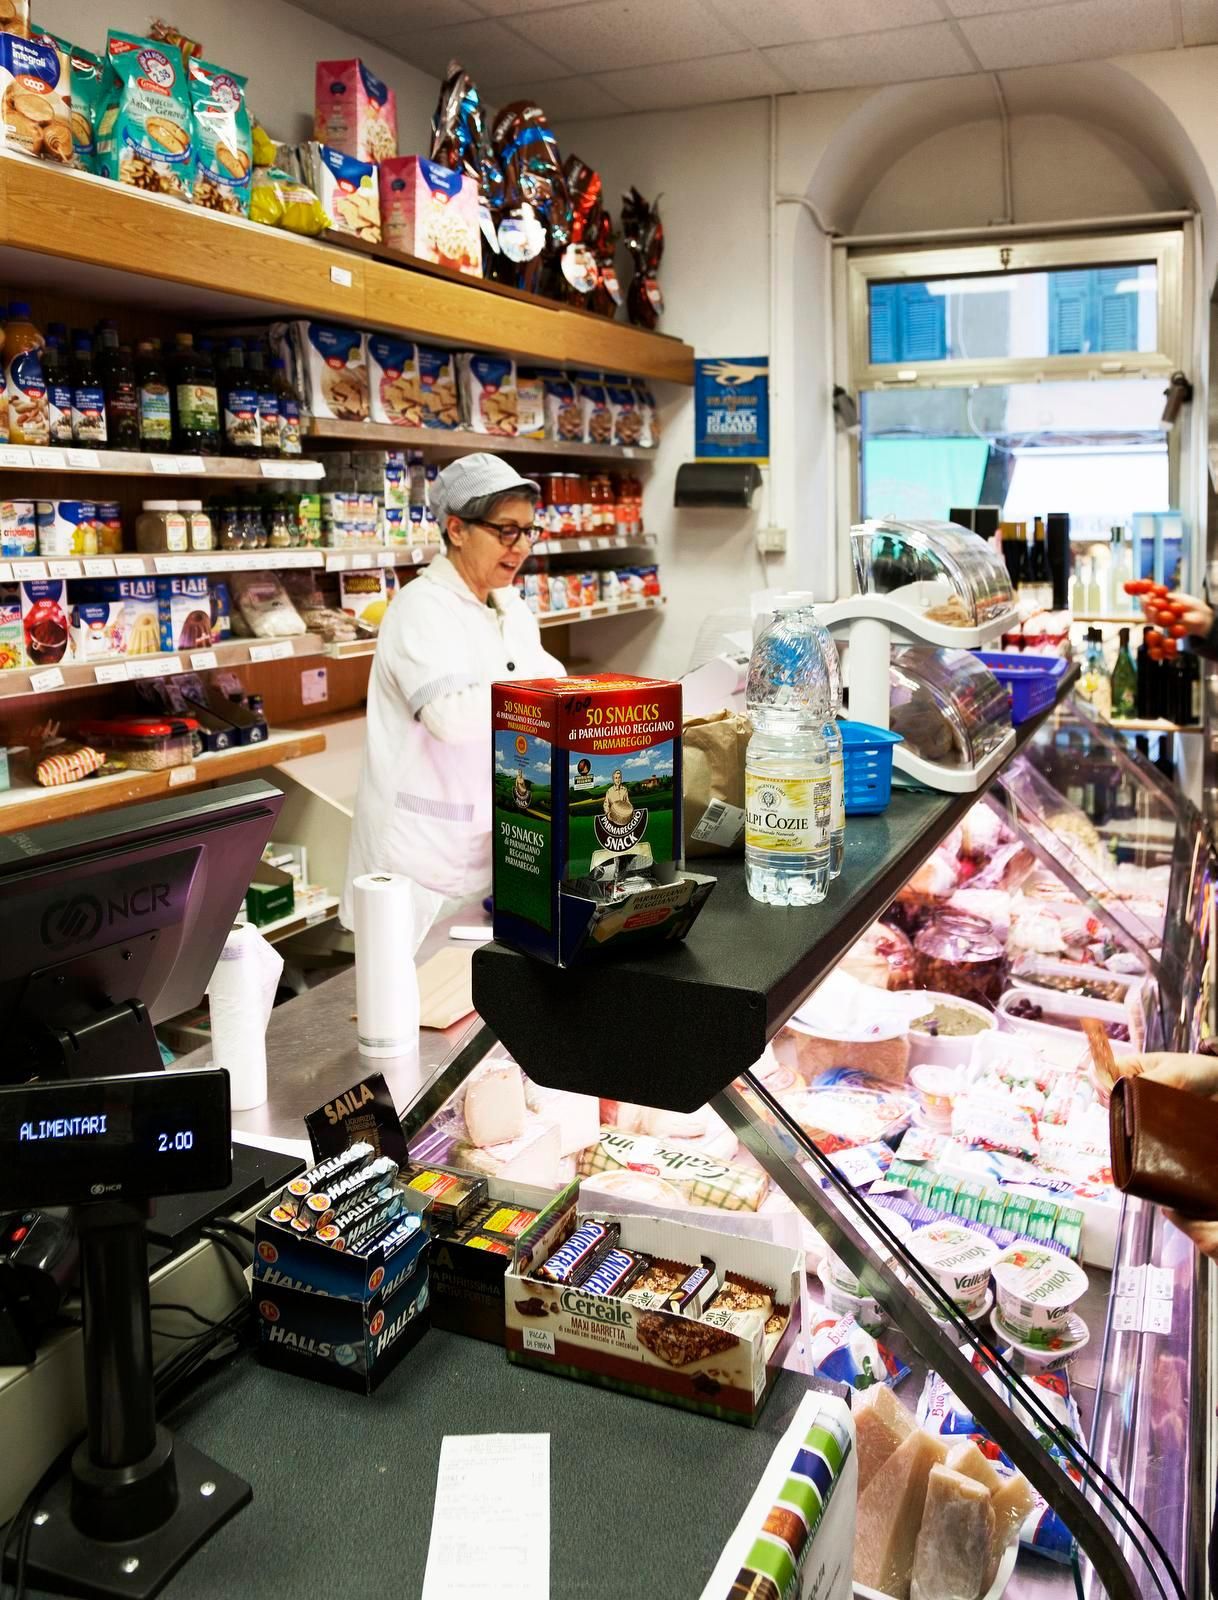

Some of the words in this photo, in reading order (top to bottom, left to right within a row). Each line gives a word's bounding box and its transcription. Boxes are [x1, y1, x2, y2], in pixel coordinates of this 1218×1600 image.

[23, 78, 45, 92] coop
[119, 580, 156, 597] ELAH
[172, 577, 208, 594] ELAH
[500, 711, 527, 724] PARMIGIANO
[527, 717, 551, 729] REGGIANO
[504, 700, 513, 713] 50
[513, 702, 542, 719] SNACKS
[585, 708, 603, 727] 50
[605, 703, 660, 723] SNACKS
[568, 728, 577, 741] di
[578, 724, 632, 740] PARMIGIANO
[633, 720, 675, 737] REGGIANO
[593, 735, 652, 751] PARMAREGGIO
[600, 809, 642, 836] PARMAREGGIO
[765, 813, 809, 830] COZIE
[500, 821, 511, 837] 50
[511, 825, 545, 848] SNACKS
[604, 834, 639, 852] SNACK
[509, 838, 541, 857] PARMIGIANO
[509, 847, 536, 864] REGGIANO
[107, 883, 172, 926] NCR
[323, 1083, 375, 1126] SAILA
[20, 1114, 108, 1142] ALIMENTARI
[158, 1131, 193, 1152] 2.00
[325, 1165, 374, 1201] HALLS
[335, 1195, 379, 1229] HALLS
[544, 1221, 602, 1279] SNICKERS
[262, 1266, 329, 1297] HAL
[562, 1291, 633, 1325] Cereale
[376, 1300, 416, 1358] HALLS
[528, 1329, 548, 1340] RICCA
[571, 1316, 590, 1331] MAXI
[590, 1321, 626, 1341] BARRETTA
[268, 1325, 332, 1358] HALLS
[526, 1339, 533, 1348] DI
[533, 1340, 552, 1351] FIBRA
